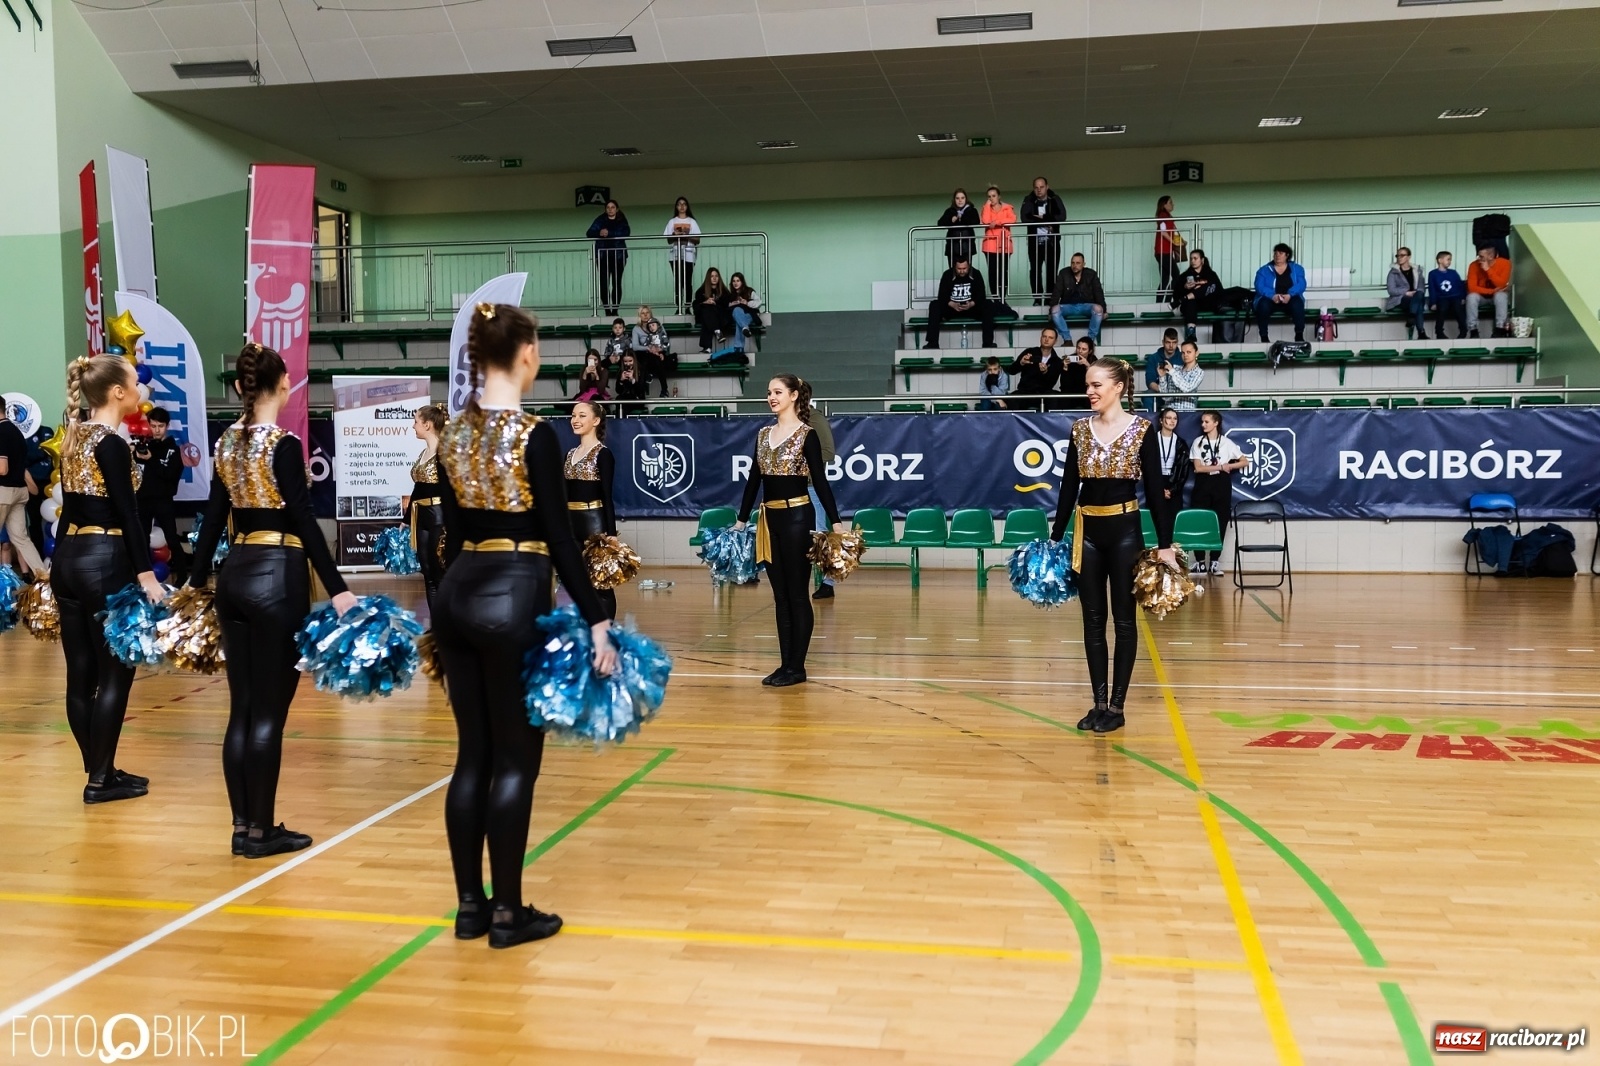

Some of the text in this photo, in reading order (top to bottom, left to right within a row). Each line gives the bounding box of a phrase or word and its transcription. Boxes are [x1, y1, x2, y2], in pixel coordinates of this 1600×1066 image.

[1168, 169, 1180, 181] B
[1188, 168, 1199, 180] B
[577, 193, 585, 204] A
[590, 192, 606, 203] A
[378, 411, 416, 419] BROOKL
[343, 426, 409, 436] BEZ UMOWY
[349, 451, 374, 459] zajęcia
[1338, 439, 1562, 480] RACIBÓRZ
[349, 460, 375, 468] zajęcia
